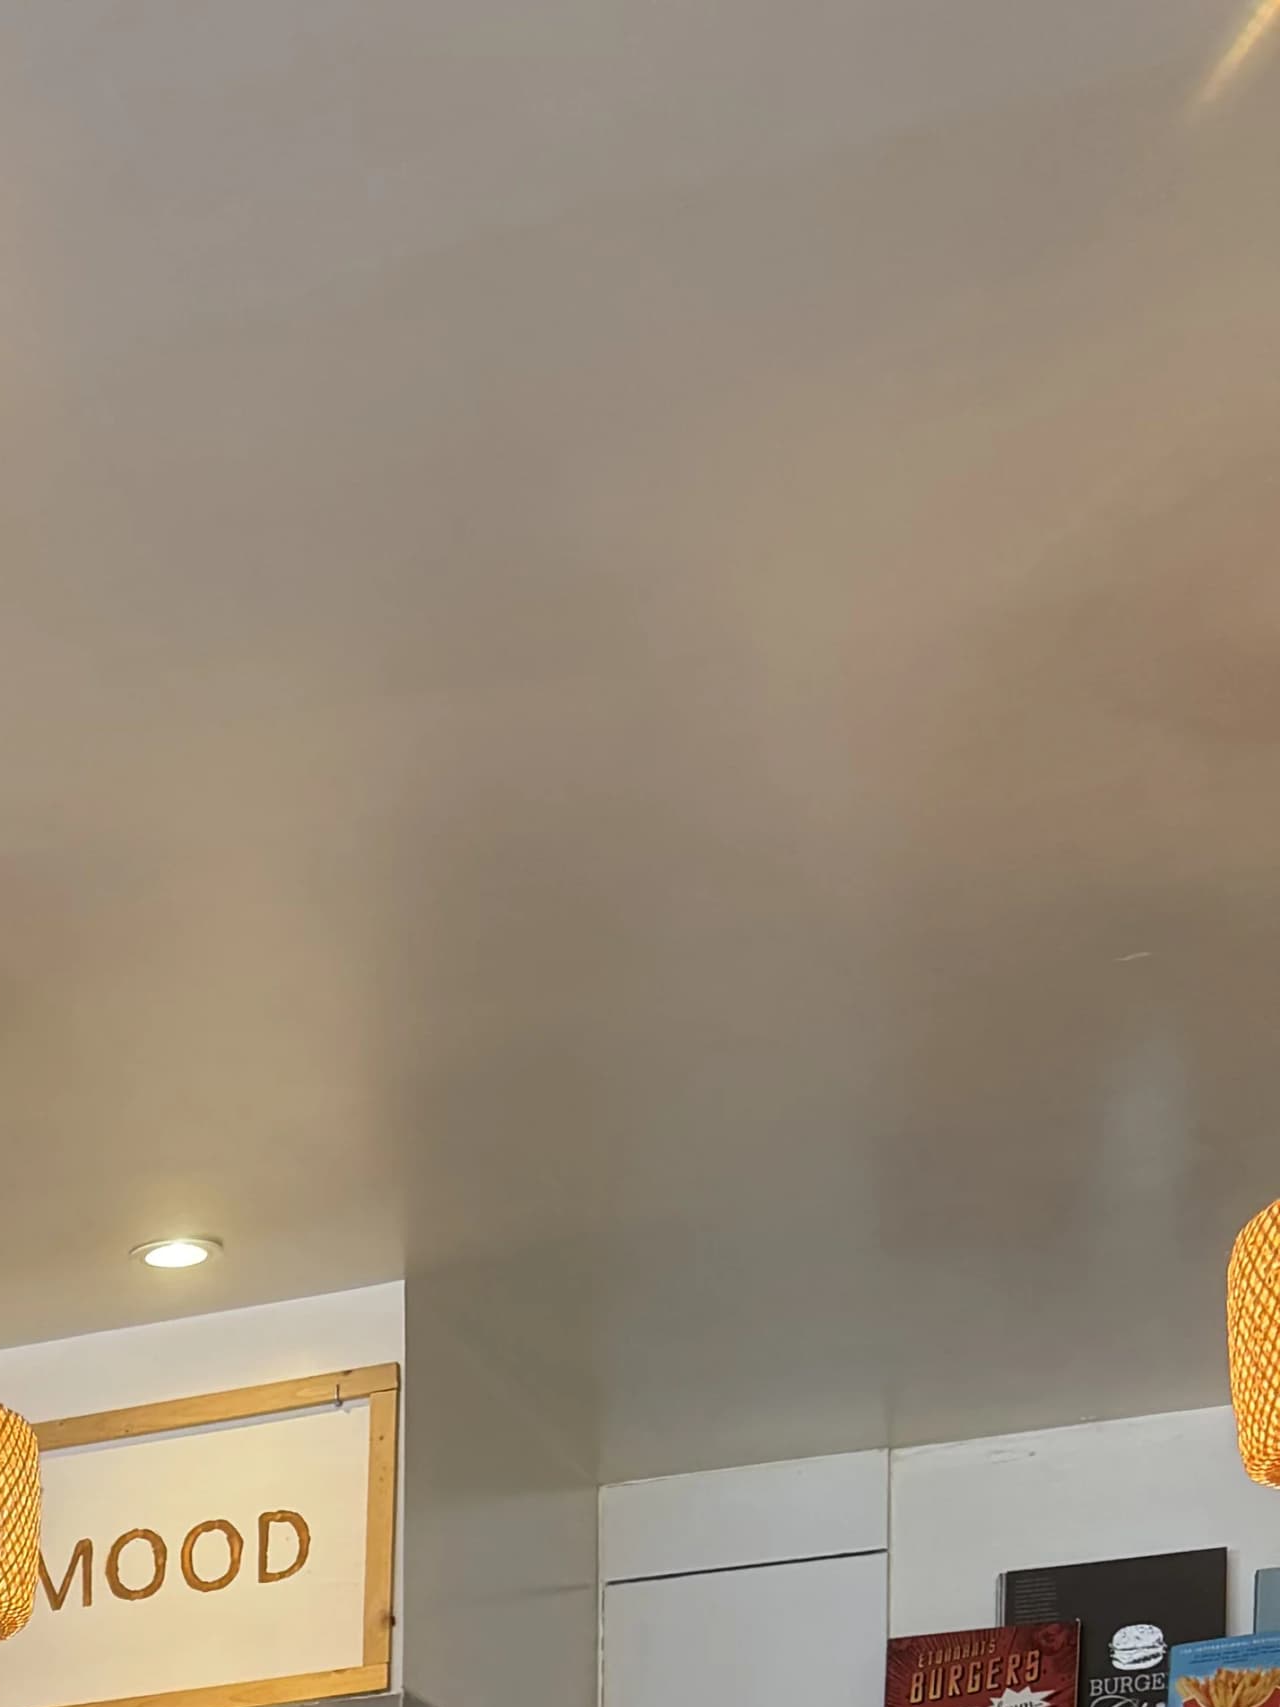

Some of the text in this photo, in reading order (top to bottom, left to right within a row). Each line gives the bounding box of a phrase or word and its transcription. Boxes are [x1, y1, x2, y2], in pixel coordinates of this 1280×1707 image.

[40, 1509, 311, 1611] MOOD
[910, 1650, 1040, 1703] BURGERS
[1089, 1672, 1169, 1697] BURGE
